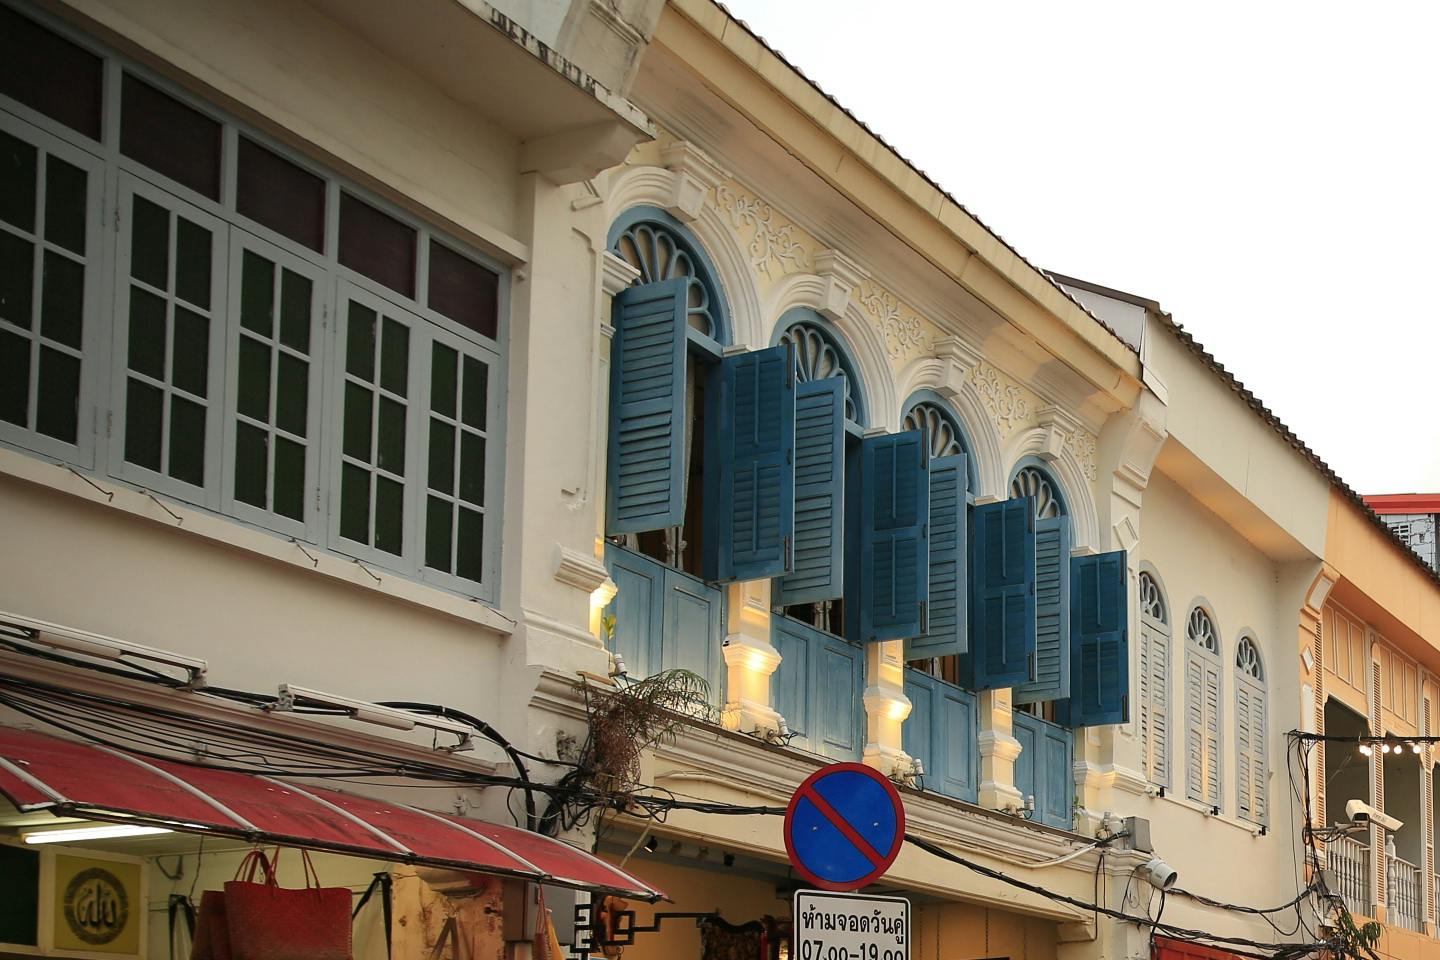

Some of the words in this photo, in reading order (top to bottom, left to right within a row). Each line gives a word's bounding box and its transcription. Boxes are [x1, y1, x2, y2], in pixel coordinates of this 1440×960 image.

[802, 904, 904, 945] ห้ามจอดวันคู่
